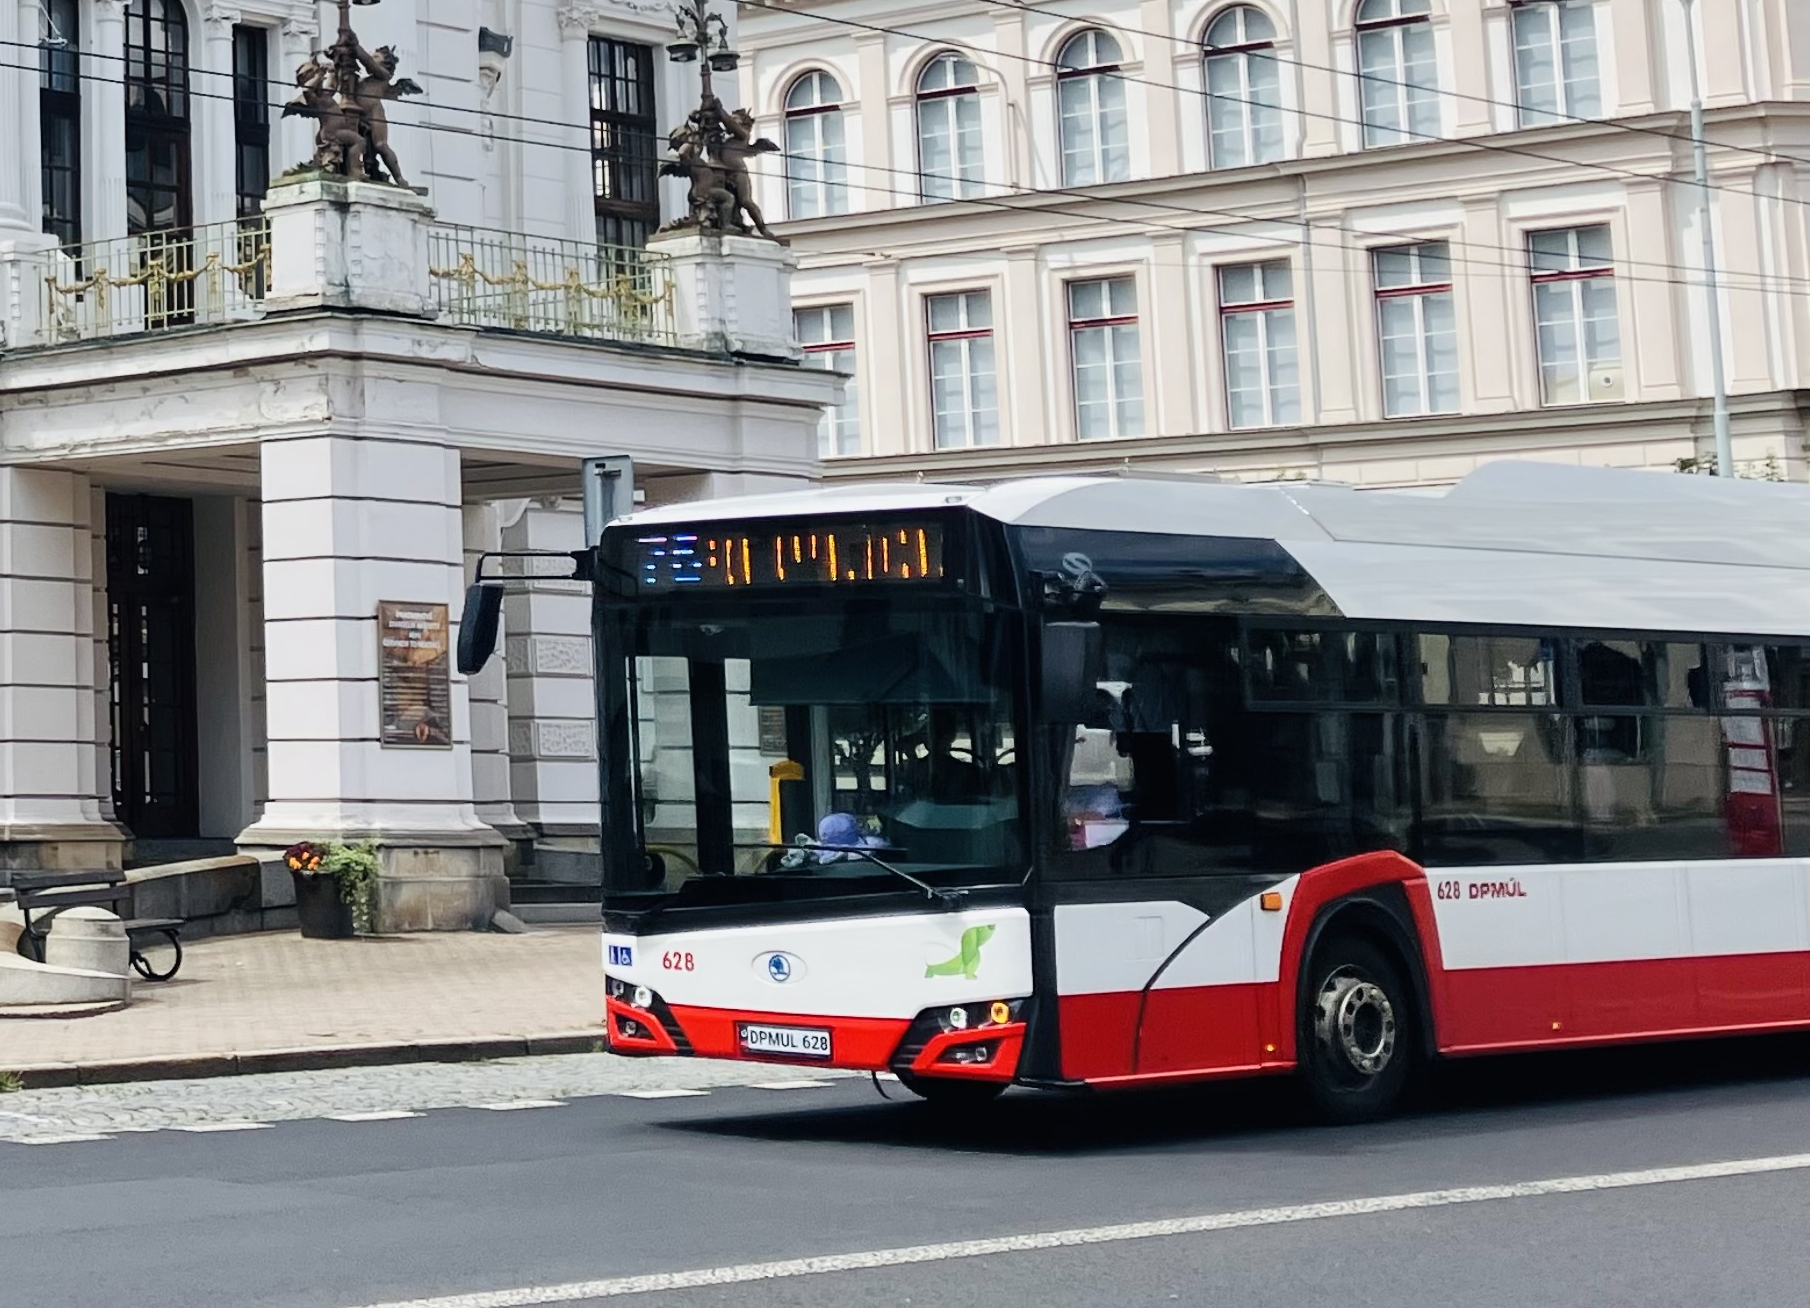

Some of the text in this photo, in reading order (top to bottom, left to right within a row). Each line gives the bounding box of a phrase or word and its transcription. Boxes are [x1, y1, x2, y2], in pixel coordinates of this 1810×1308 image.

[1437, 880, 1461, 900] 628
[662, 950, 695, 972] 628
[750, 1029, 828, 1051] DPMUL 628
